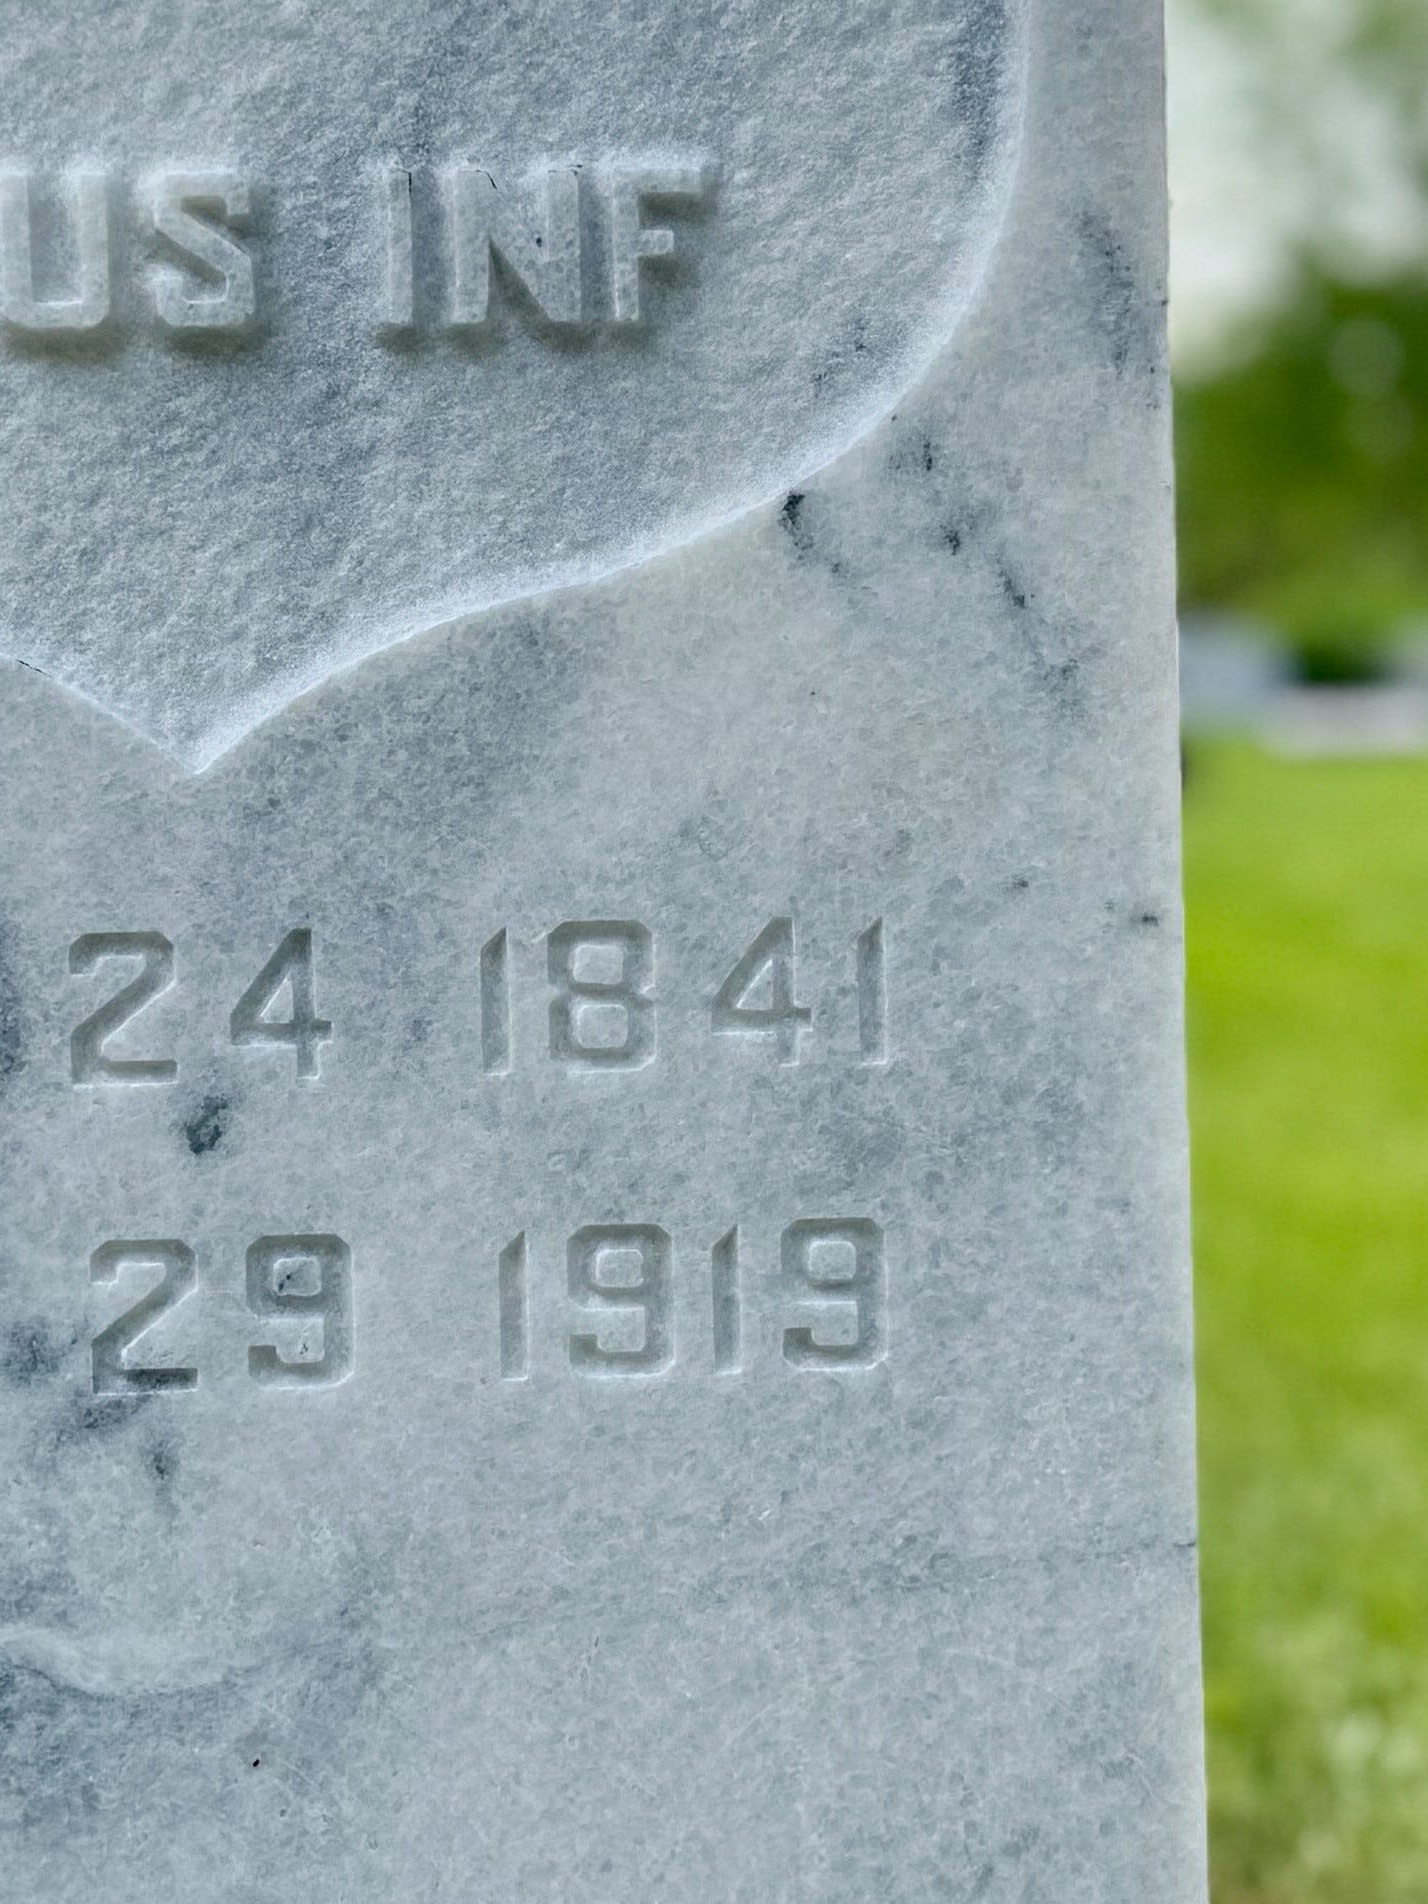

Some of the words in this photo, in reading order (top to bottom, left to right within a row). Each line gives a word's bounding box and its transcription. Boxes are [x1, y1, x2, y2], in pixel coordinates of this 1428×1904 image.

[380, 154, 716, 330] INF
[69, 924, 334, 1086] 24
[478, 914, 890, 1076] 1841
[89, 1231, 356, 1396] 29
[497, 1216, 889, 1382] 1919
